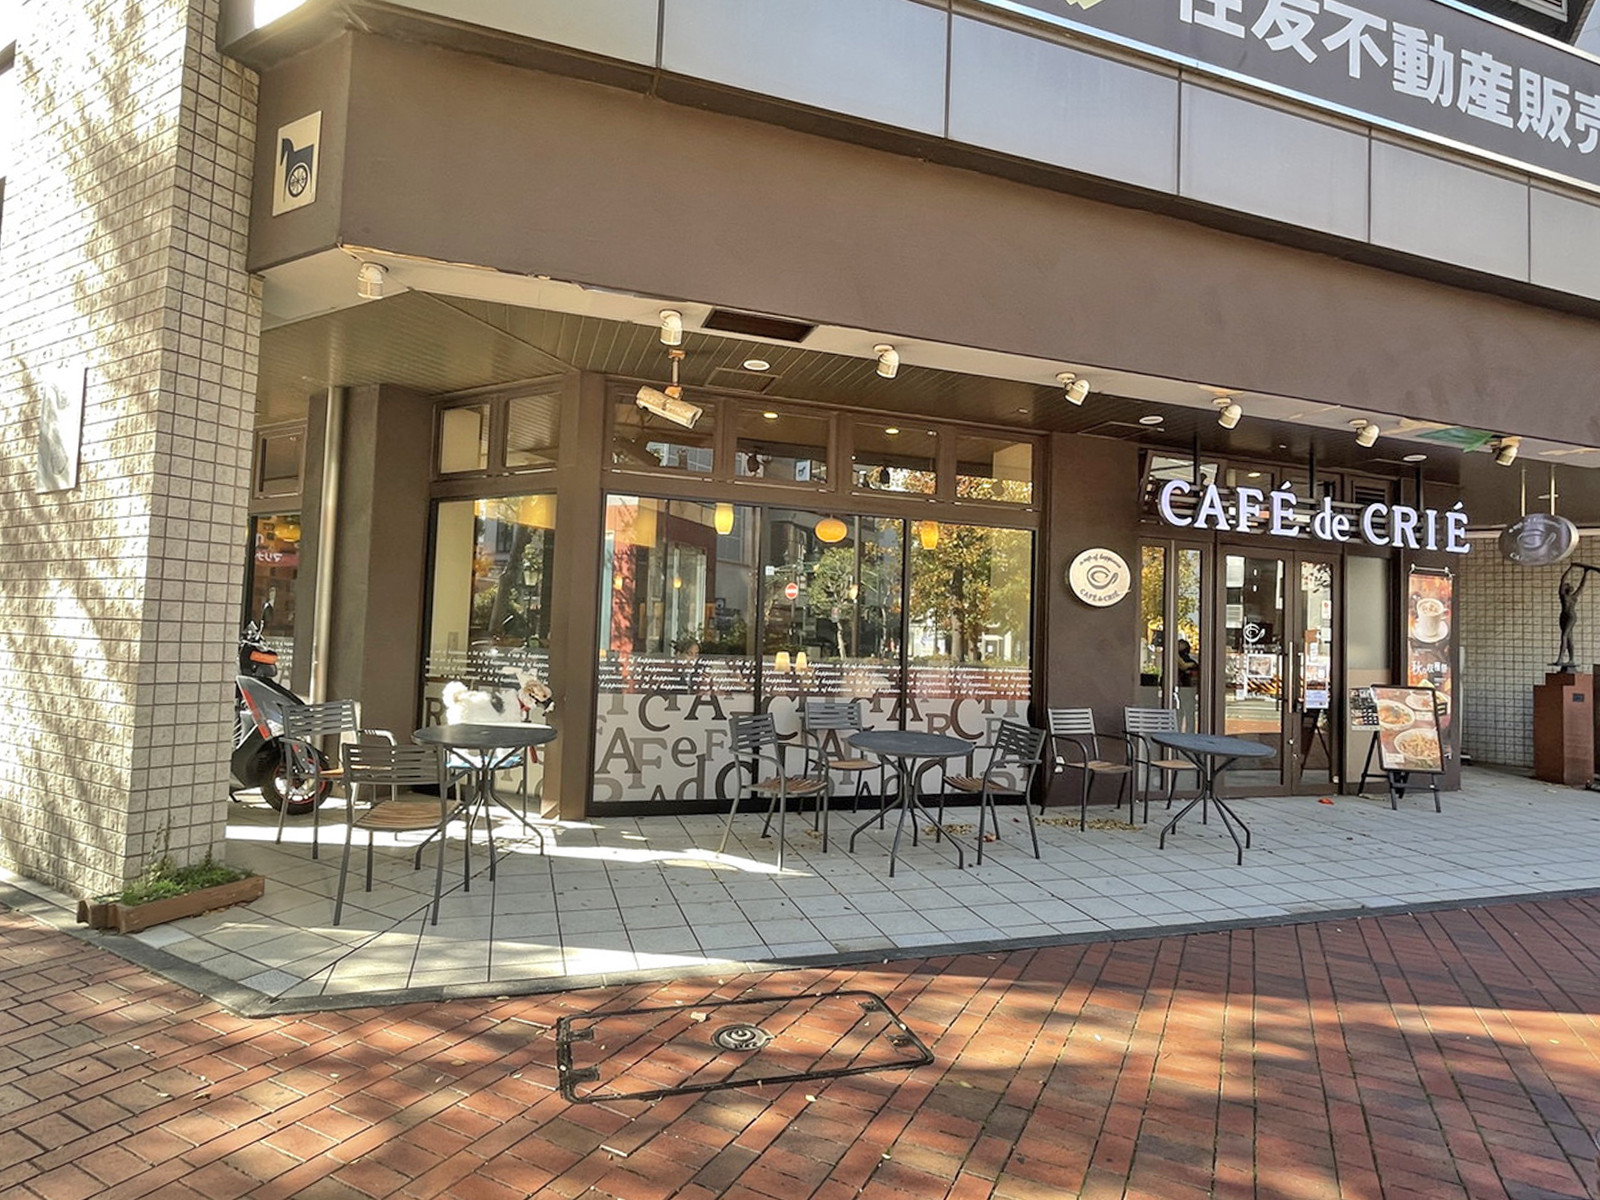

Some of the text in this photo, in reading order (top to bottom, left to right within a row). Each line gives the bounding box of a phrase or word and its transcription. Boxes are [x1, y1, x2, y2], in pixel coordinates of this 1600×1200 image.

[1160, 480, 1471, 553] CAFÉ de CRIÉ
